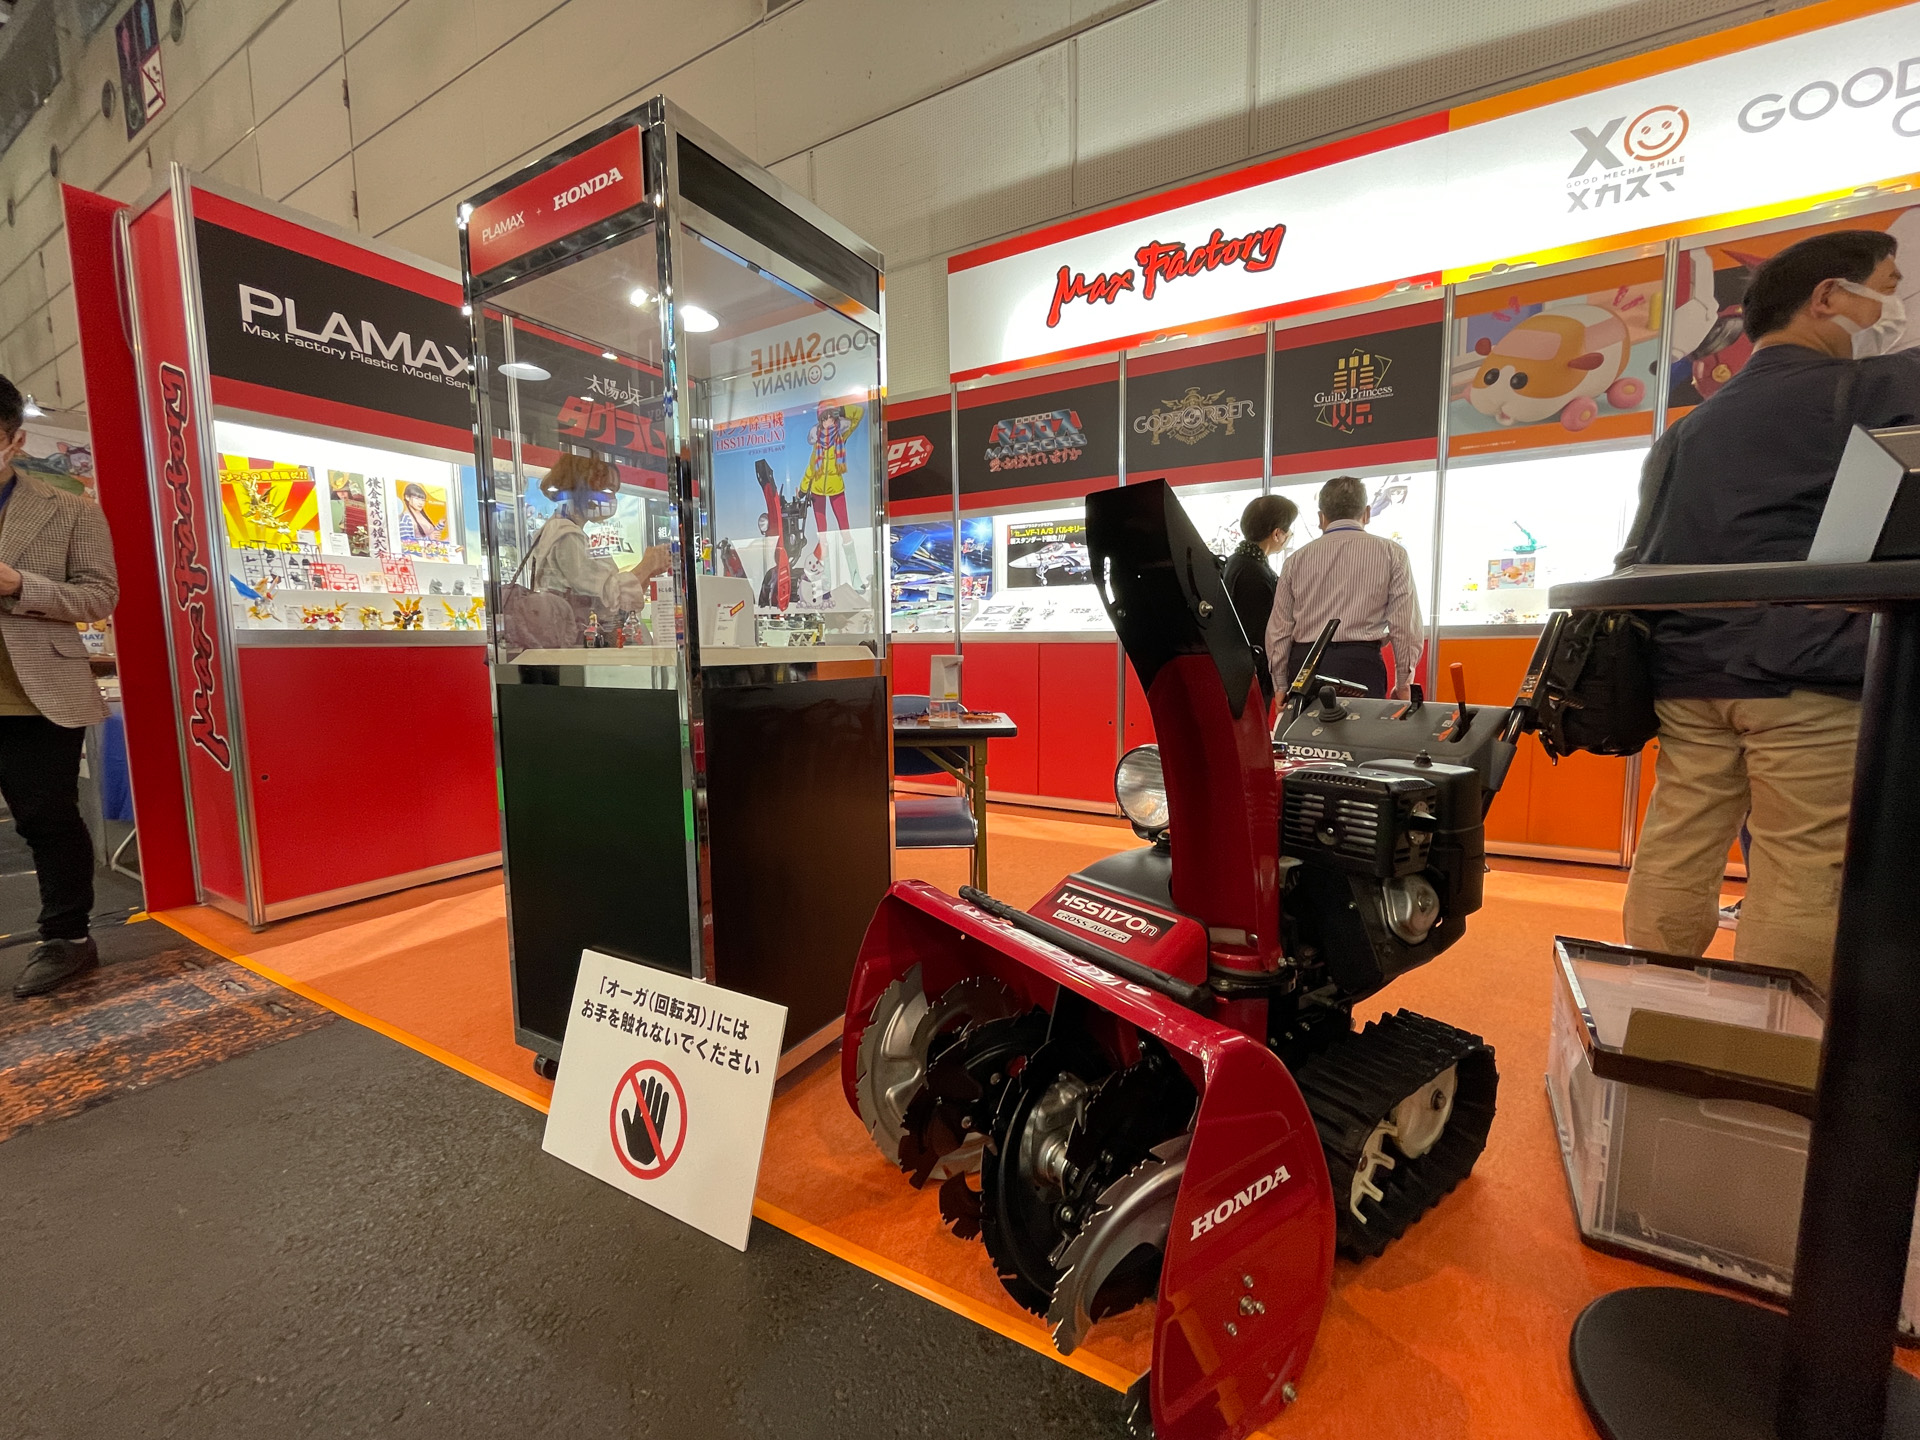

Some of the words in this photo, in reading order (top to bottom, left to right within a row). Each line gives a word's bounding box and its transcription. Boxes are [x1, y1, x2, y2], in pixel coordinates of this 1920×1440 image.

[1566, 176, 1598, 188] GOOD
[1604, 166, 1644, 180] MECHA
[1650, 156, 1685, 170] SMILE
[1567, 166, 1684, 213] メカスマ
[482, 211, 525, 242] PLAMAX
[553, 167, 623, 211] HONDA
[1046, 265, 1135, 328] Max
[1134, 224, 1286, 300] Factory
[239, 284, 470, 378] PLAMAX
[242, 322, 281, 341] Max
[285, 333, 346, 360] Factory
[350, 350, 399, 372] Plastic
[402, 364, 442, 383] Model
[446, 376, 470, 390] Seri
[1314, 390, 1348, 404] Guilty
[1350, 386, 1393, 399] Princess
[716, 411, 785, 437] ホンダ除雪機
[716, 428, 785, 451] HSS1170n(JX)
[888, 439, 925, 461] ロス
[984, 433, 1088, 461] MACROSS
[1288, 745, 1354, 761] HONDA
[1055, 911, 1088, 927] CROSS
[1090, 923, 1127, 942] AUGER
[1057, 893, 1159, 937] HSS1170n
[599, 975, 750, 1041] 「オーガ(回転刃)」には
[581, 999, 761, 1075] お手を触れないでください
[1190, 1165, 1291, 1241] HONDA
